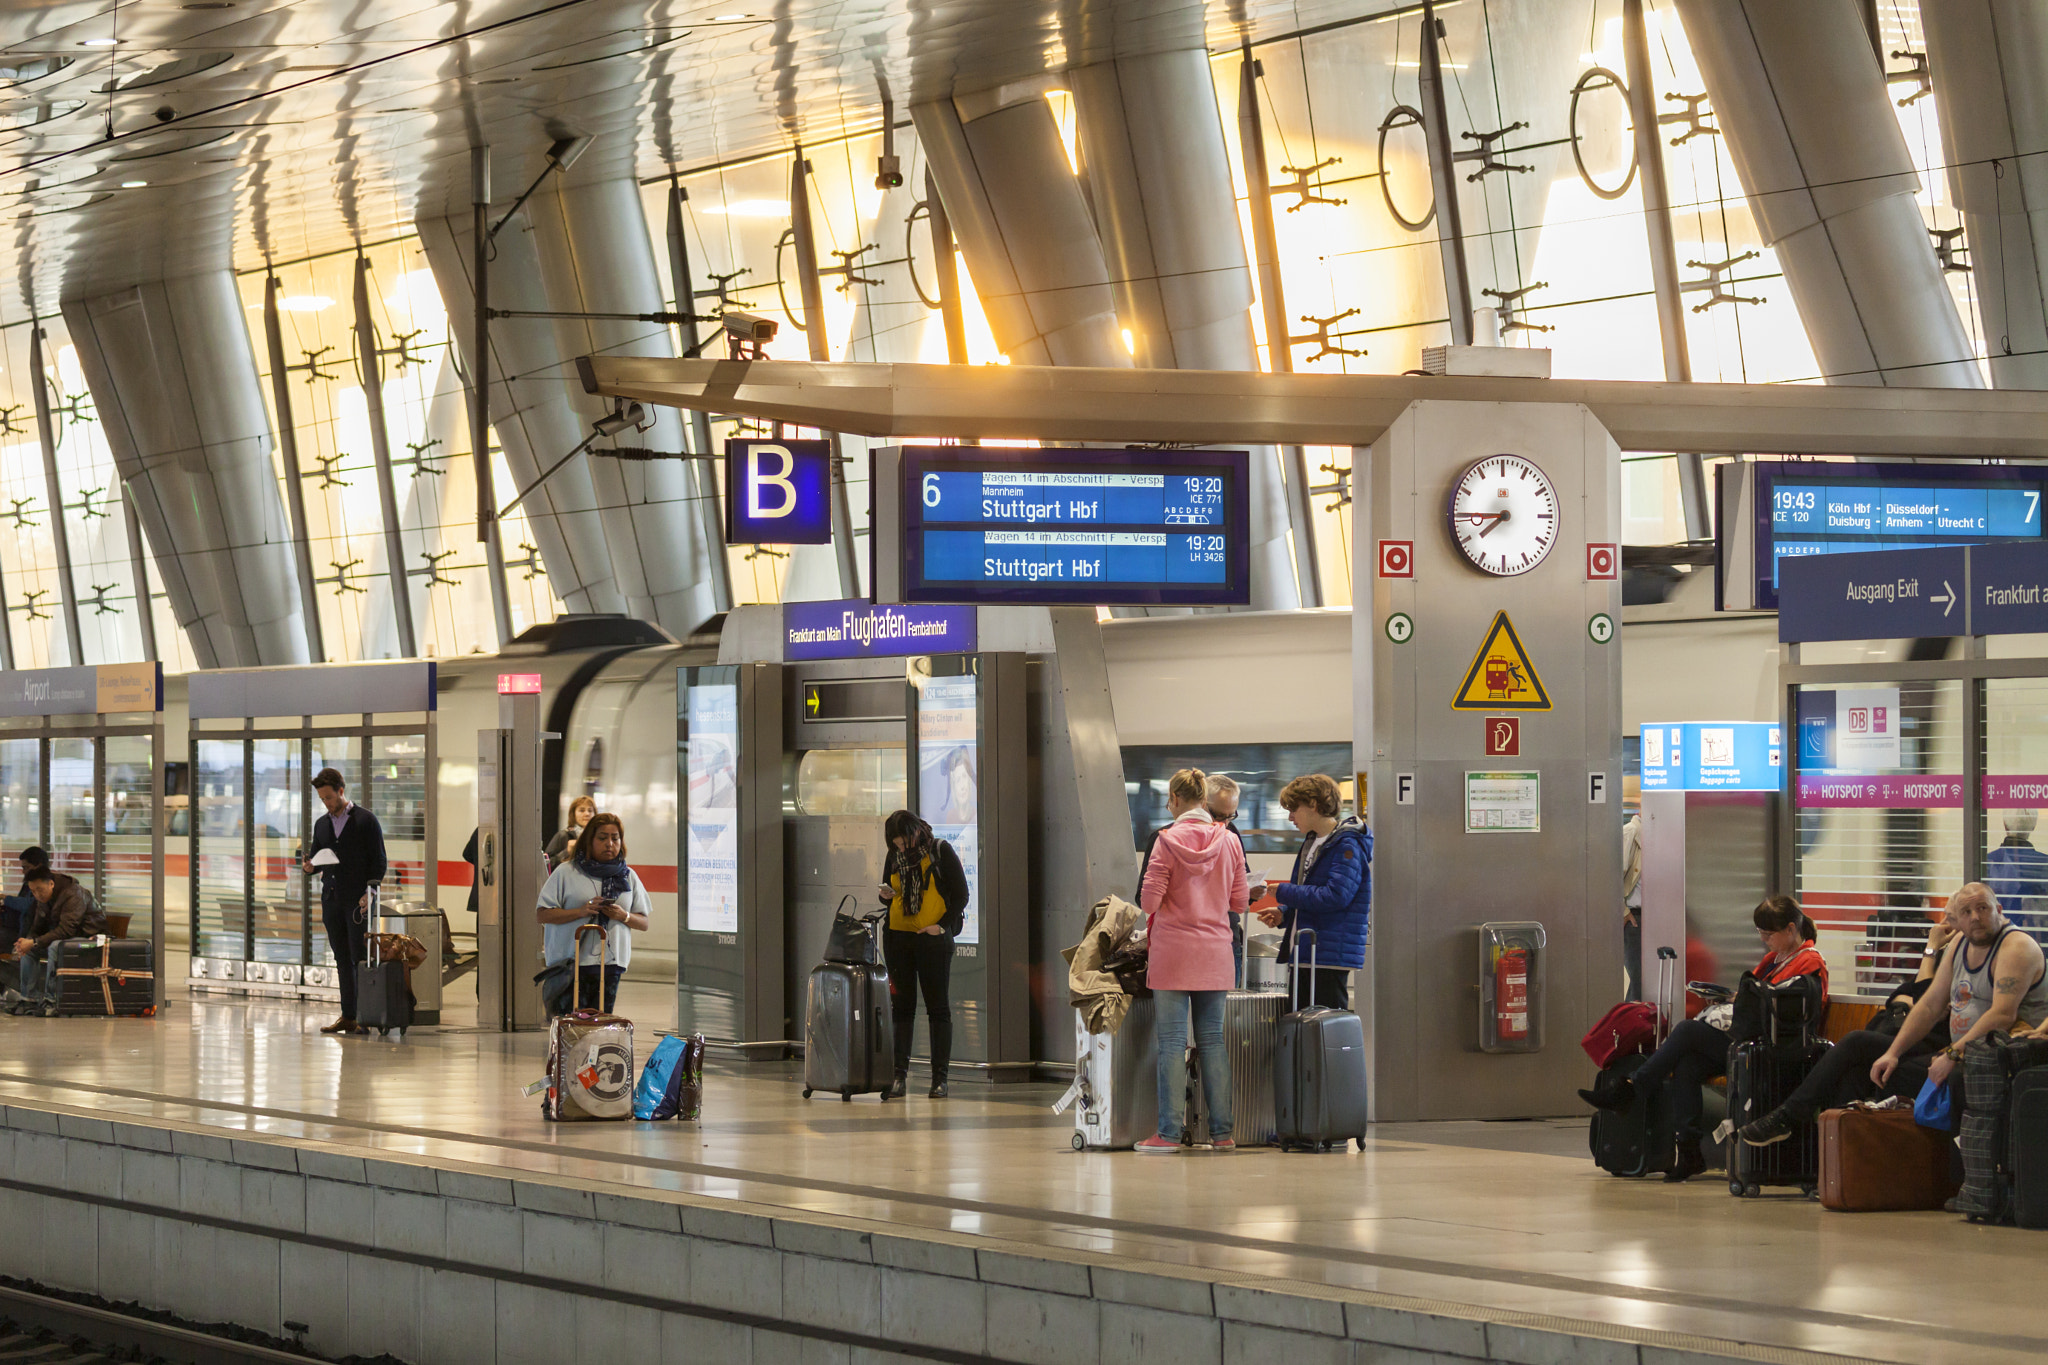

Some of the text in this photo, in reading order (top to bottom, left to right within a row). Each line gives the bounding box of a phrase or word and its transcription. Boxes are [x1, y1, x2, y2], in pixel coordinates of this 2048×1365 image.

[748, 444, 797, 518] B
[983, 473, 1017, 484] Wagen
[1023, 473, 1032, 483] 14
[1037, 473, 1049, 483] im
[1053, 474, 1102, 484] Abschnitt
[1107, 475, 1113, 483] F
[1184, 478, 1221, 493] 19:20
[923, 473, 941, 507] 6
[982, 486, 1023, 496] Mannheim
[1190, 494, 1221, 504] ICE 771
[982, 500, 1098, 522] Stuttgart Hbf
[1773, 491, 2040, 523] 19:43 7
[1828, 502, 1850, 514] Köln
[1854, 503, 1871, 514] Hbf
[1886, 503, 1939, 515] Düsseldorf
[1773, 512, 1809, 522] ICE 120
[1828, 516, 1871, 529] Duisburg
[1886, 517, 1923, 528] Arnhem
[1938, 517, 1974, 529] Utrecht
[1978, 518, 1985, 529] C
[985, 532, 1019, 543] Wagen
[1025, 533, 1035, 541] 14
[1039, 533, 1051, 542] im
[1056, 533, 1106, 542] Abschnitt
[1110, 534, 1116, 542] F
[1186, 536, 1224, 550] 19:20
[1190, 553, 1224, 562] LH 3426
[985, 559, 1101, 582] Stuttgart Hbf
[1846, 578, 1919, 604] Ausgang Exit
[1986, 584, 2040, 605] Frankfurt
[789, 608, 947, 646] Frankfurt am Main Flughafen Fernbahnhof
[24, 678, 50, 707] Airport
[1851, 712, 1866, 729] DB
[1700, 767, 1740, 776] Gepäckwagen
[1399, 775, 1412, 802] F
[1591, 775, 1604, 801] F
[1700, 776, 1725, 786] Baggage
[1821, 784, 1863, 799] HOTSPOT
[1903, 784, 1947, 799] HOTSPOT
[2009, 784, 2048, 799] HOTSPO
[956, 946, 977, 957] STRÖER
